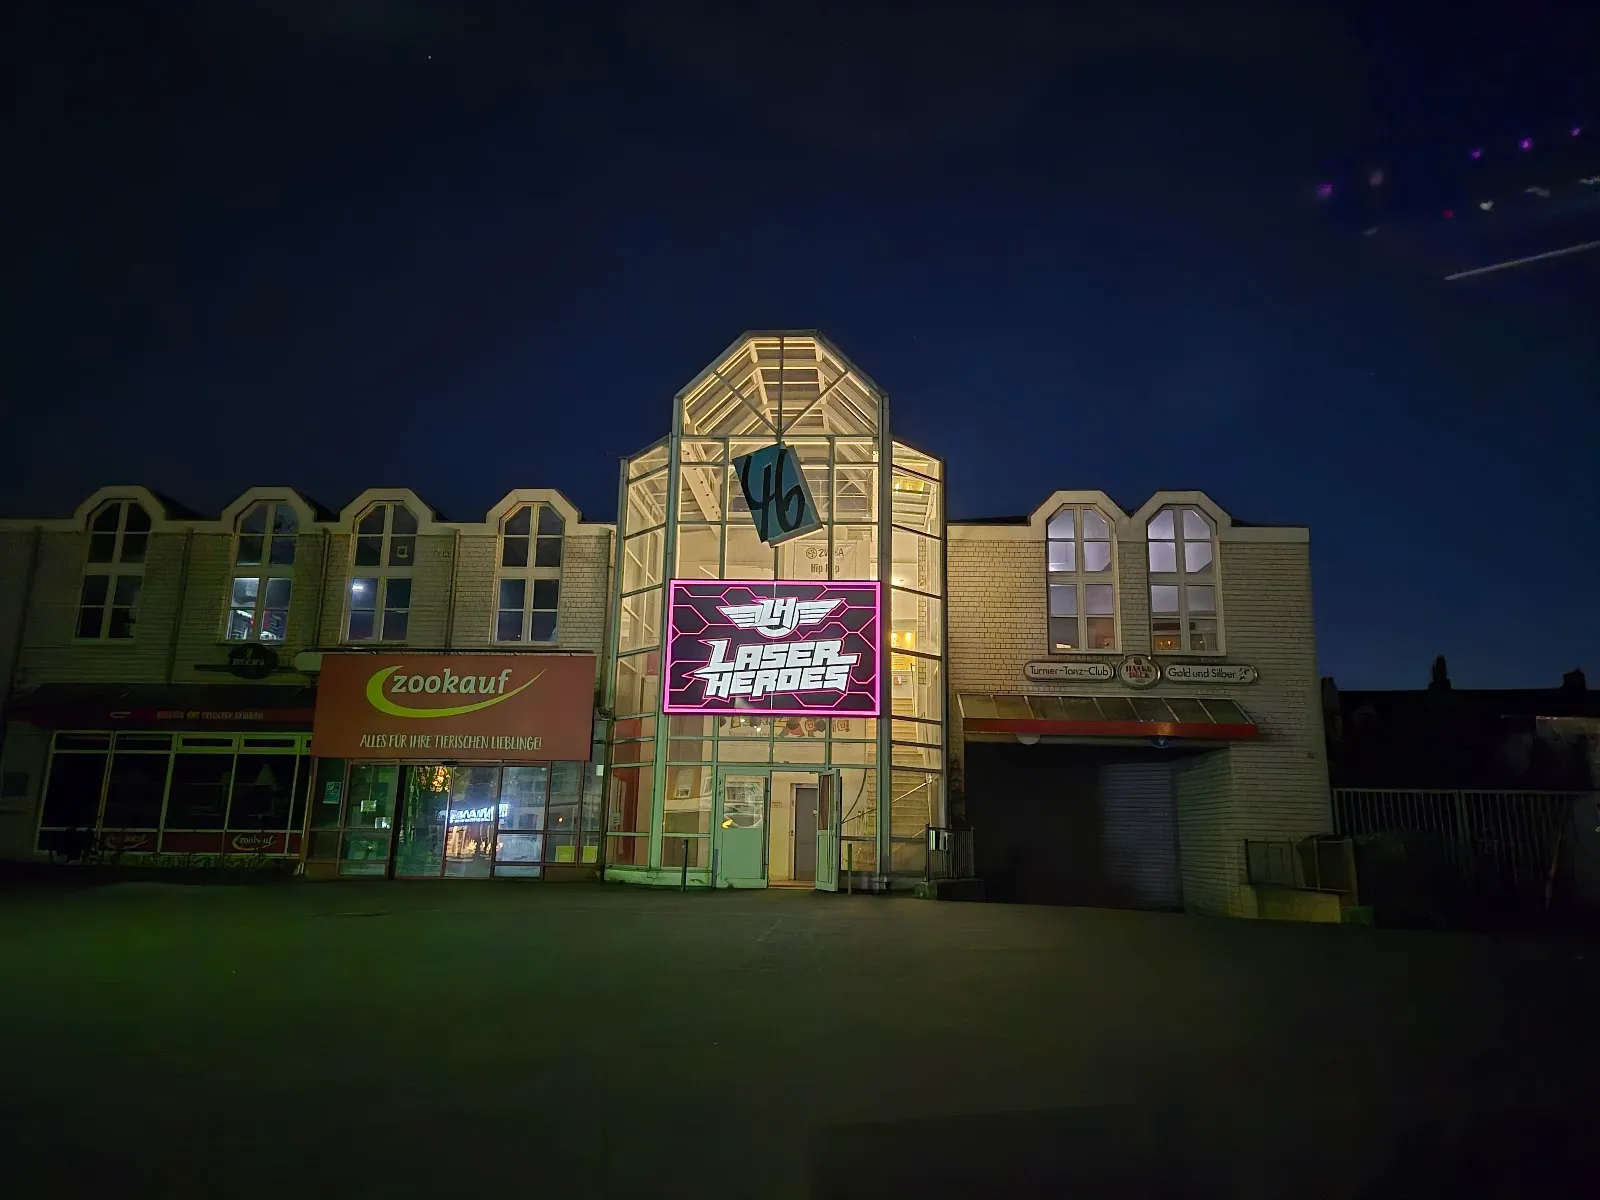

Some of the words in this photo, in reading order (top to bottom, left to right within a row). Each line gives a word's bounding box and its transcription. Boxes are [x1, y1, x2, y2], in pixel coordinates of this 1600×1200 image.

[741, 448, 806, 542] 46
[811, 563, 823, 574] Hip
[694, 639, 858, 674] LASER
[391, 668, 513, 694] zookauf
[705, 665, 851, 699] HEROES
[1168, 667, 1191, 678] Gold
[1193, 668, 1210, 678] und
[1211, 667, 1236, 679] Silber
[360, 734, 387, 748] ALLES
[409, 735, 432, 749] IHRE
[433, 734, 489, 750] TIERISCHEN
